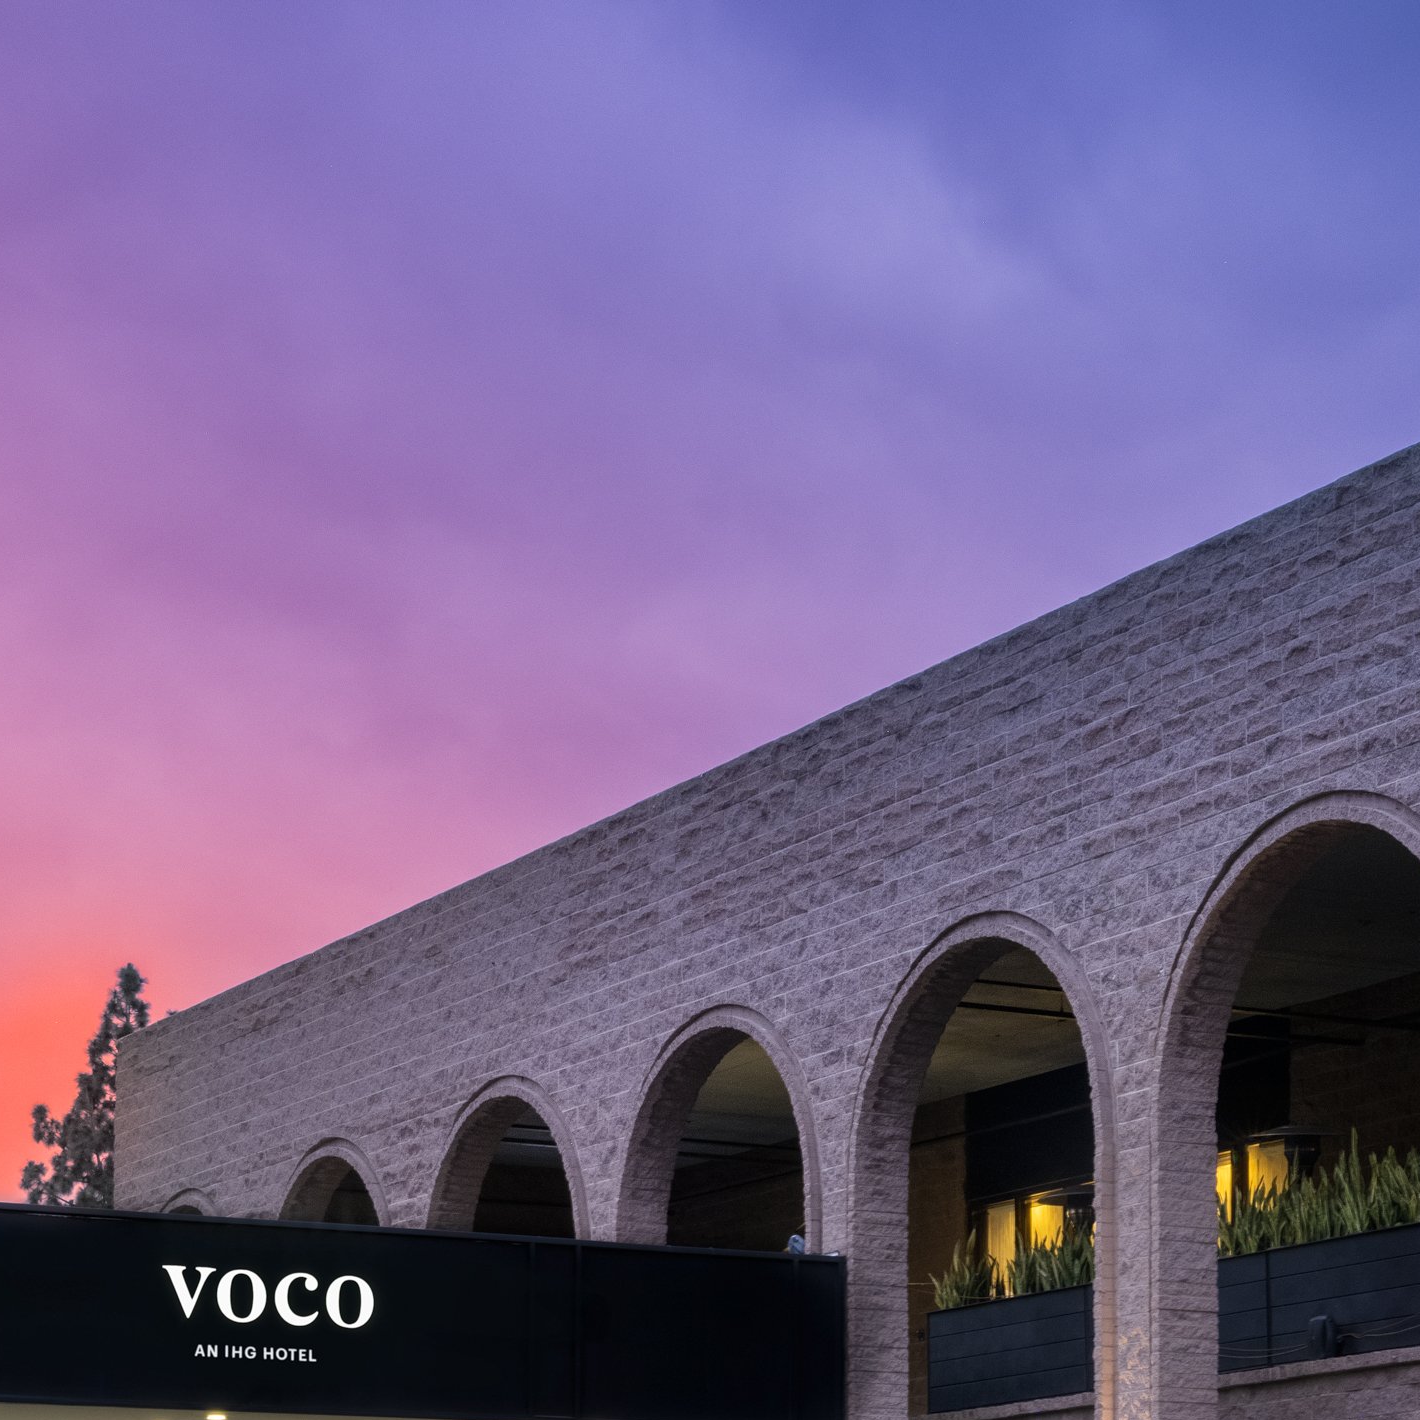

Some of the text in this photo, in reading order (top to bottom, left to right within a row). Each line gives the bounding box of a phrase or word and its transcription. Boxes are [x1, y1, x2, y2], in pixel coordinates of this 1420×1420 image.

[194, 1344, 317, 1362] AN IHG HOTEL
